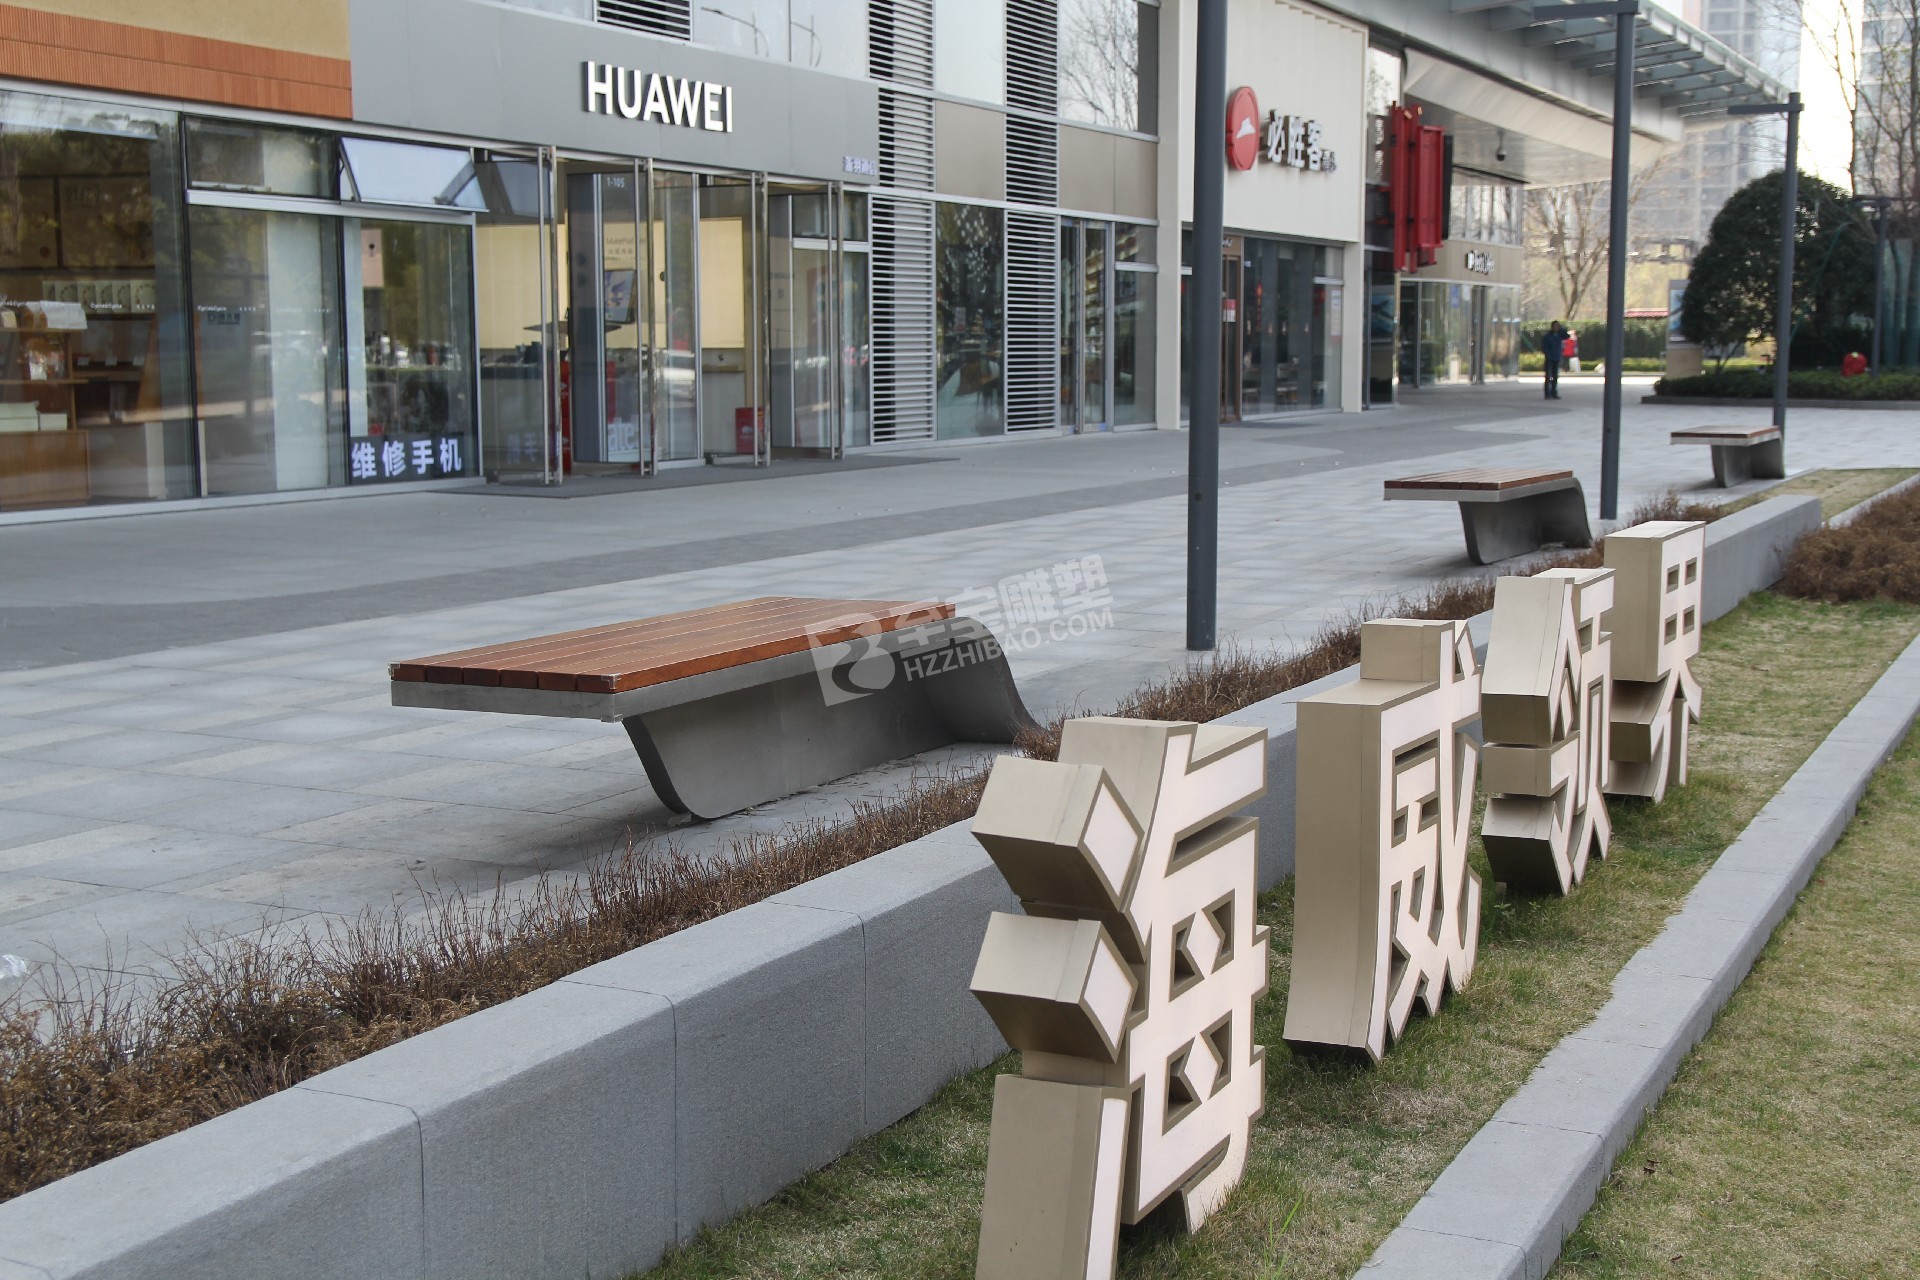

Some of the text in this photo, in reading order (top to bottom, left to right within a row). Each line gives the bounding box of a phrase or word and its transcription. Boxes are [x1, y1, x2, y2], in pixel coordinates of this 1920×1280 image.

[585, 60, 733, 133] HUAWEI
[1266, 109, 1323, 171] 必胜客
[351, 437, 462, 480] 维修手机
[971, 521, 1705, 1280] 海威领界
